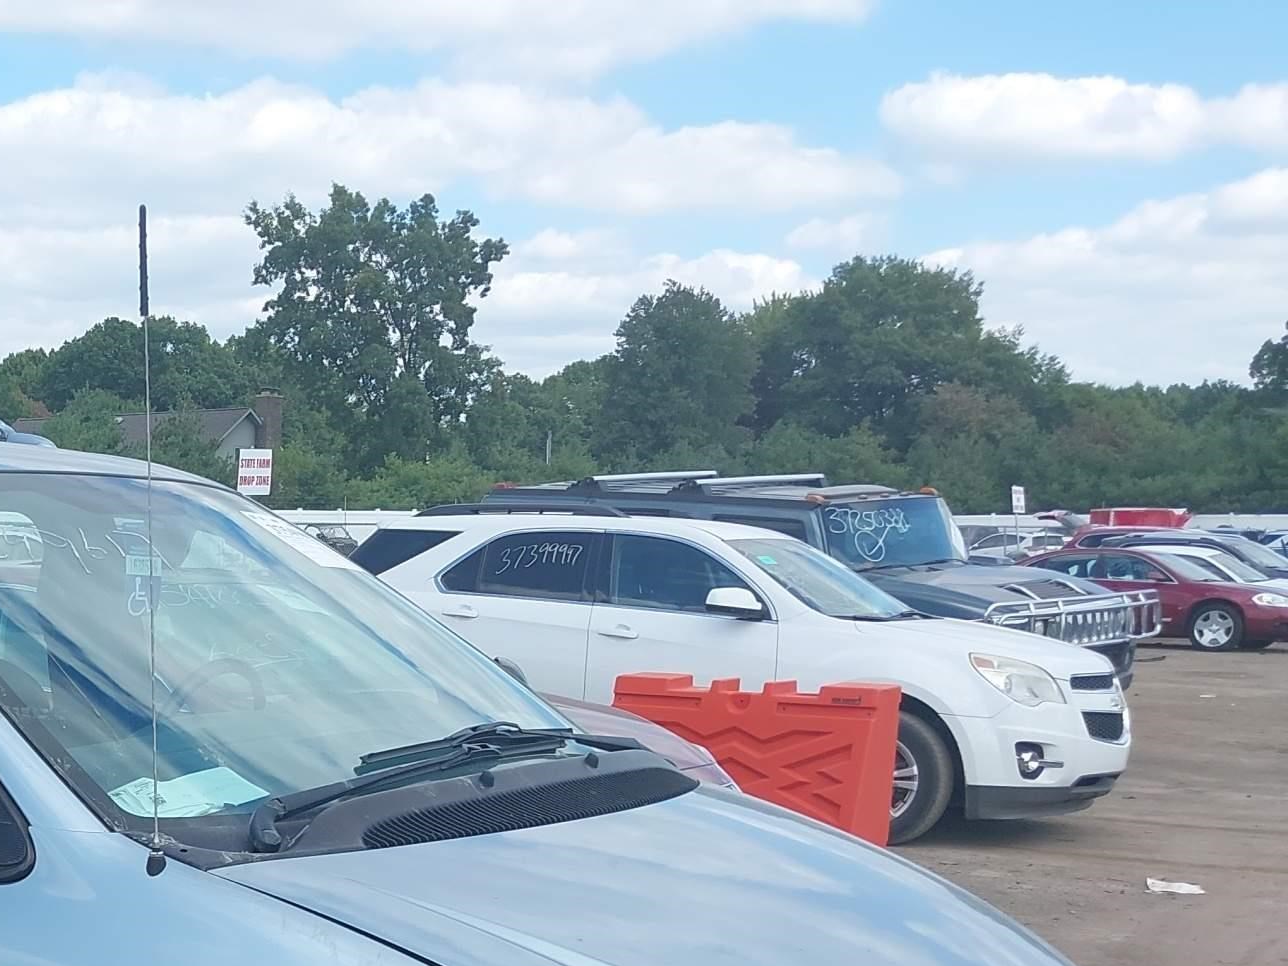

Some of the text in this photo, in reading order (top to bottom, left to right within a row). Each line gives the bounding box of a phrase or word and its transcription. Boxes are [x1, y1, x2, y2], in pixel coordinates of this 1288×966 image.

[240, 458, 271, 469] STATE FARM
[239, 475, 270, 486] DROP ZONE
[495, 542, 583, 575] 37399997
